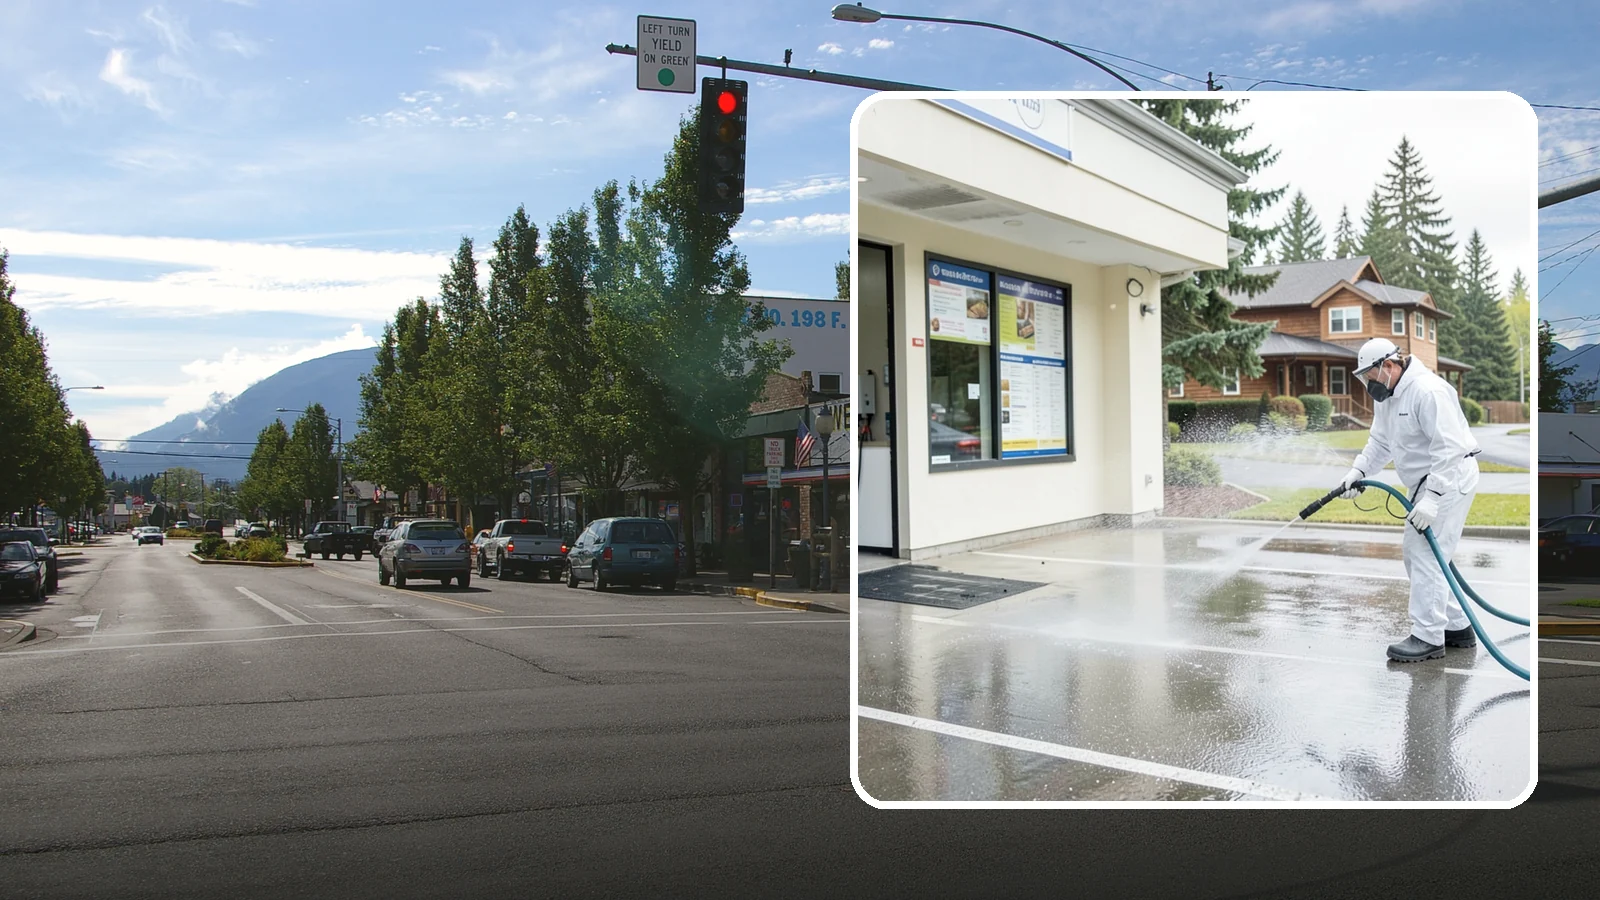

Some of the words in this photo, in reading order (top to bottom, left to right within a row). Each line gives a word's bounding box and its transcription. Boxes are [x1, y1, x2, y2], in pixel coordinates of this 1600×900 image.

[643, 24, 663, 34] LEFT
[668, 26, 690, 36] TURN
[652, 38, 682, 52] YIELD
[644, 53, 656, 63] ON
[661, 55, 689, 66] GREEN
[791, 309, 826, 328] 198
[831, 311, 847, 329] F.
